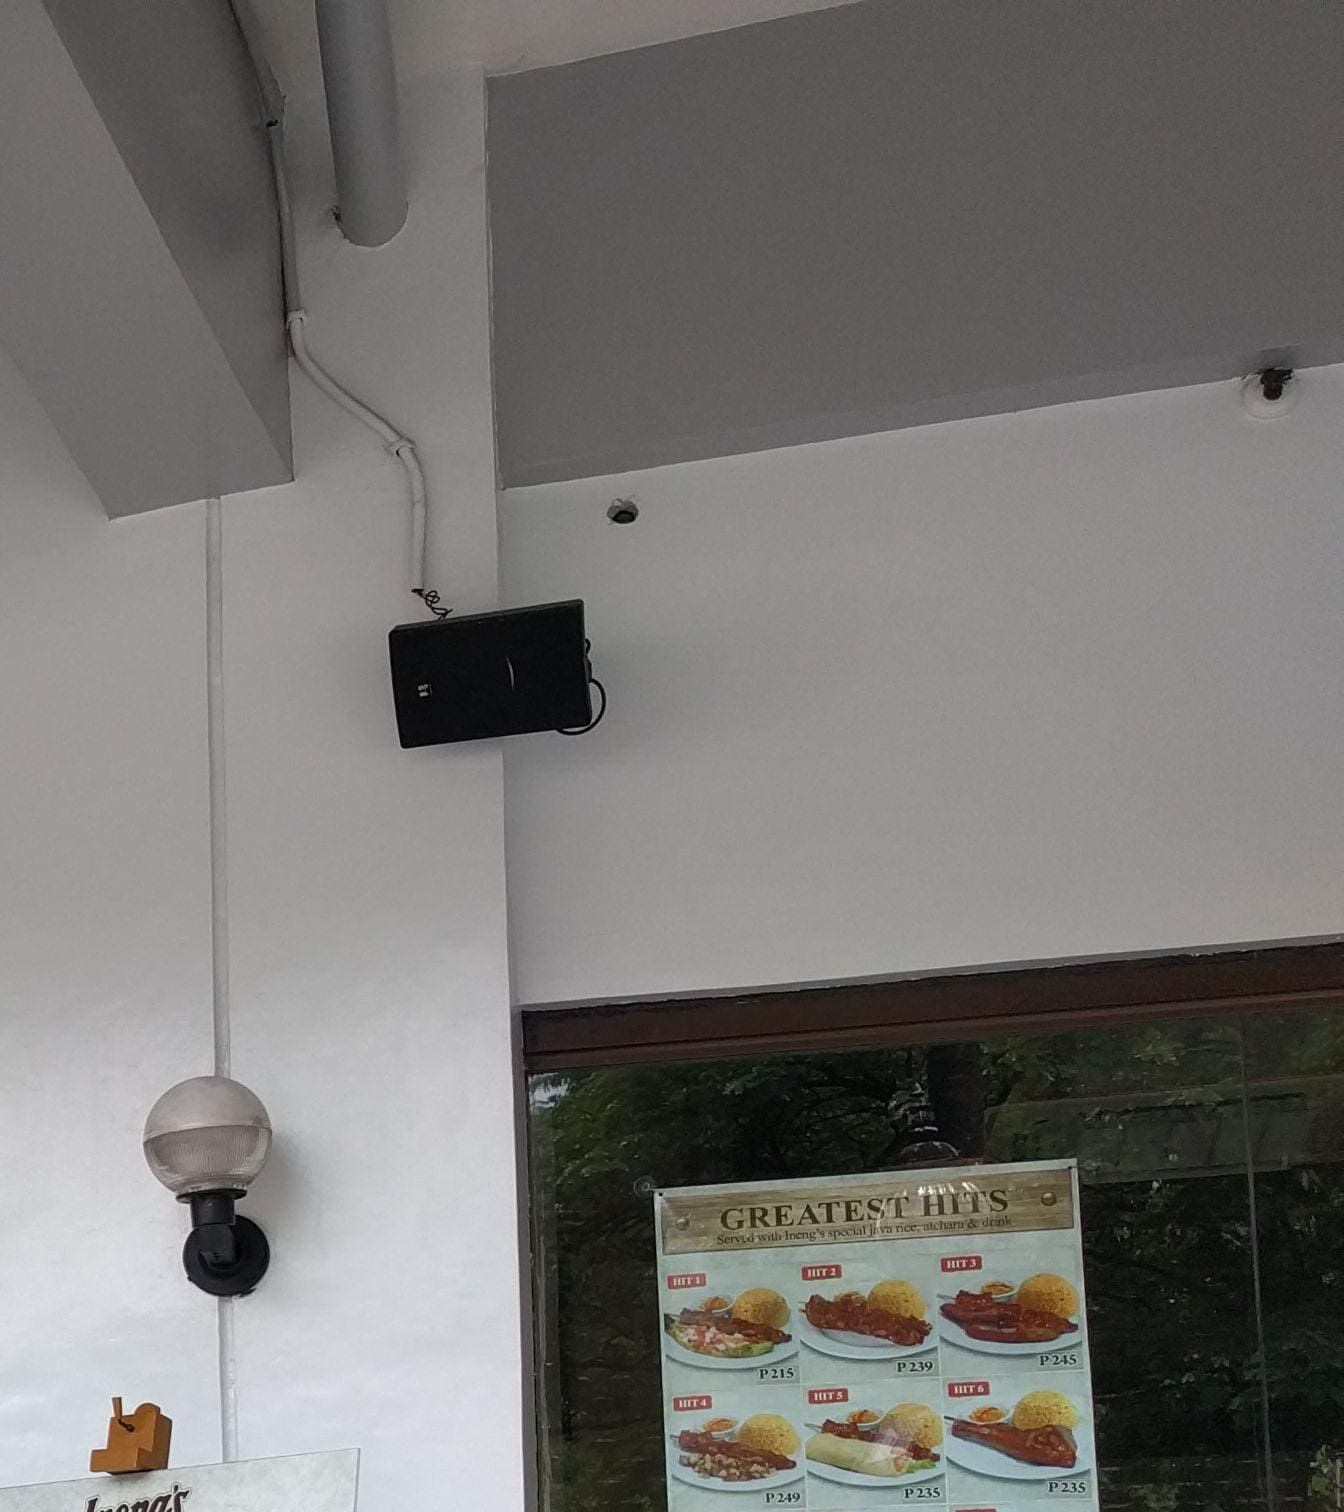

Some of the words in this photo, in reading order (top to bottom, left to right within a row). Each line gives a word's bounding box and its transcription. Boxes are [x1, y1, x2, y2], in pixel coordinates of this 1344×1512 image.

[720, 1195, 910, 1231] GREATEST
[921, 1189, 1009, 1217] HITS
[716, 1234, 755, 1245] Served
[757, 1232, 782, 1242] with
[784, 1227, 826, 1243] Ineng's
[827, 1226, 866, 1240] special
[967, 1218, 978, 1229] &
[982, 1216, 1012, 1228] drink
[946, 1258, 967, 1269] HIT
[970, 1258, 977, 1268] 3
[807, 1268, 827, 1279] HIT
[830, 1267, 836, 1277] 2
[673, 1276, 692, 1286] HIT
[695, 1275, 700, 1285] 1
[1039, 1355, 1051, 1366] P
[1053, 1353, 1077, 1366] 245
[897, 1361, 908, 1373] P
[910, 1360, 933, 1372] 239
[759, 1369, 770, 1379] P
[771, 1367, 794, 1379] 215
[954, 1384, 974, 1394] HIT
[977, 1383, 984, 1394] 6
[814, 1391, 834, 1401] HIT
[837, 1390, 843, 1401] 5
[678, 1399, 698, 1410] HIT
[700, 1398, 707, 1408] 4
[904, 1487, 916, 1499] P
[916, 1486, 941, 1499] 235
[1048, 1482, 1061, 1494] P
[1061, 1481, 1087, 1494] 235
[765, 1492, 776, 1504] P
[777, 1491, 800, 1503] 249
